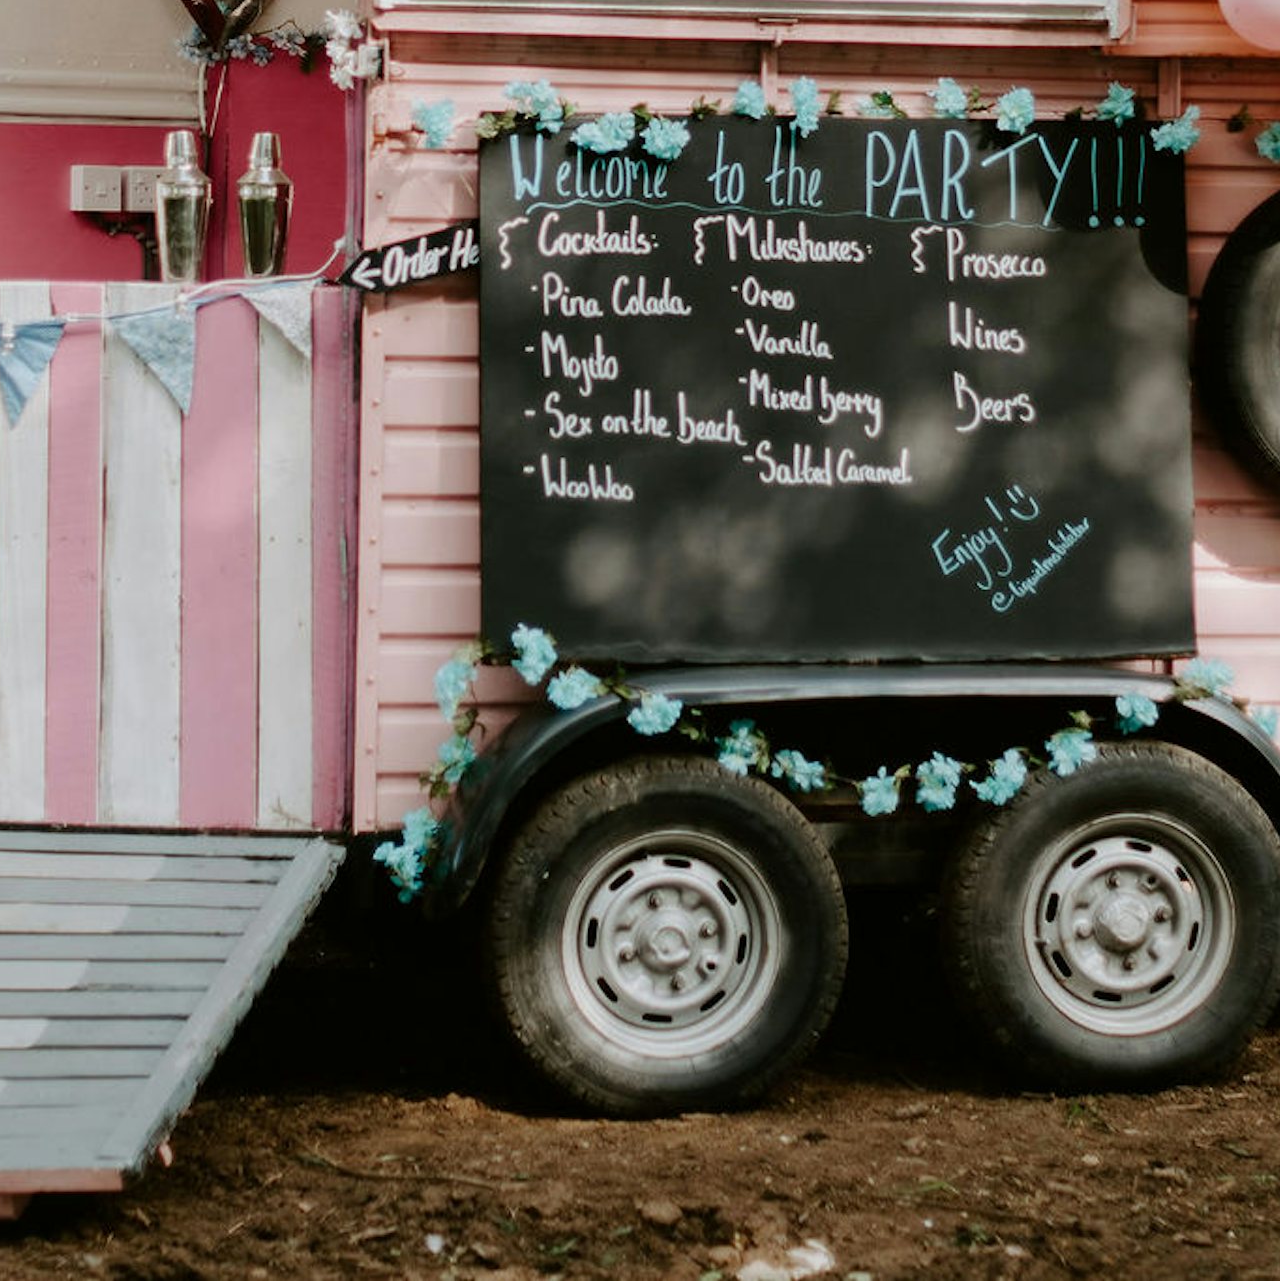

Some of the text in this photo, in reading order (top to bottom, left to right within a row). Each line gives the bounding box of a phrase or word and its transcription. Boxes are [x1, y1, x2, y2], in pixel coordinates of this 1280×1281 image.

[510, 125, 1145, 228] Welcome to the PARTY!!!
[383, 228, 480, 286] Order He
[537, 210, 658, 257] Cocktails:
[947, 228, 1046, 281] Prosecco
[542, 271, 691, 318] Pina Colada
[742, 276, 795, 310] Oreo
[745, 318, 834, 360] Vanilla
[949, 300, 1026, 353] Wines
[541, 330, 618, 397] Mojito
[543, 391, 592, 439] Sex
[677, 391, 748, 445] beach
[749, 368, 881, 438] Mixed berry
[954, 371, 1035, 432] Beers
[755, 440, 912, 485] Salted Caramel
[930, 496, 1012, 590] Enjoy!
